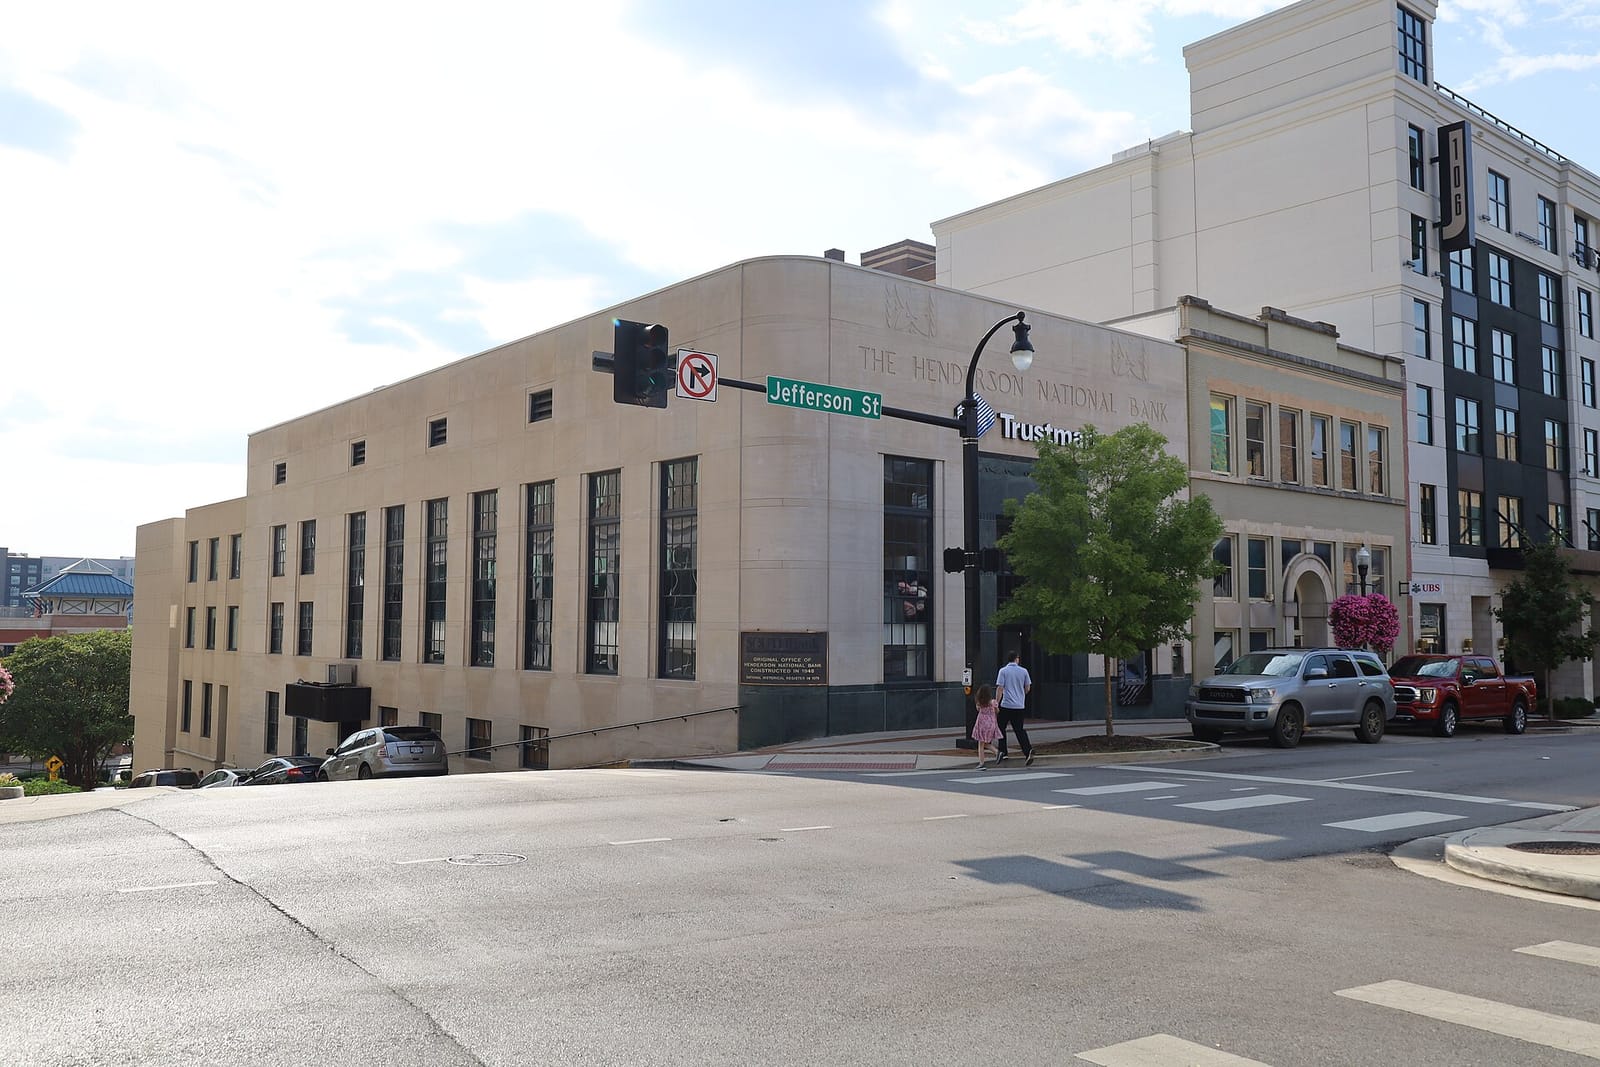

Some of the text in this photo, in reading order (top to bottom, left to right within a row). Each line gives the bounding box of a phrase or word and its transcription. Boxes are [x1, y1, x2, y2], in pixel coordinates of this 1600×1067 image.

[1452, 138, 1462, 217] 106
[770, 381, 879, 416] Jefferson St
[858, 345, 1169, 423] THE HENDRSON NATIONAL BANK
[1000, 412, 1096, 449] Trustma
[1422, 583, 1441, 593] UBS
